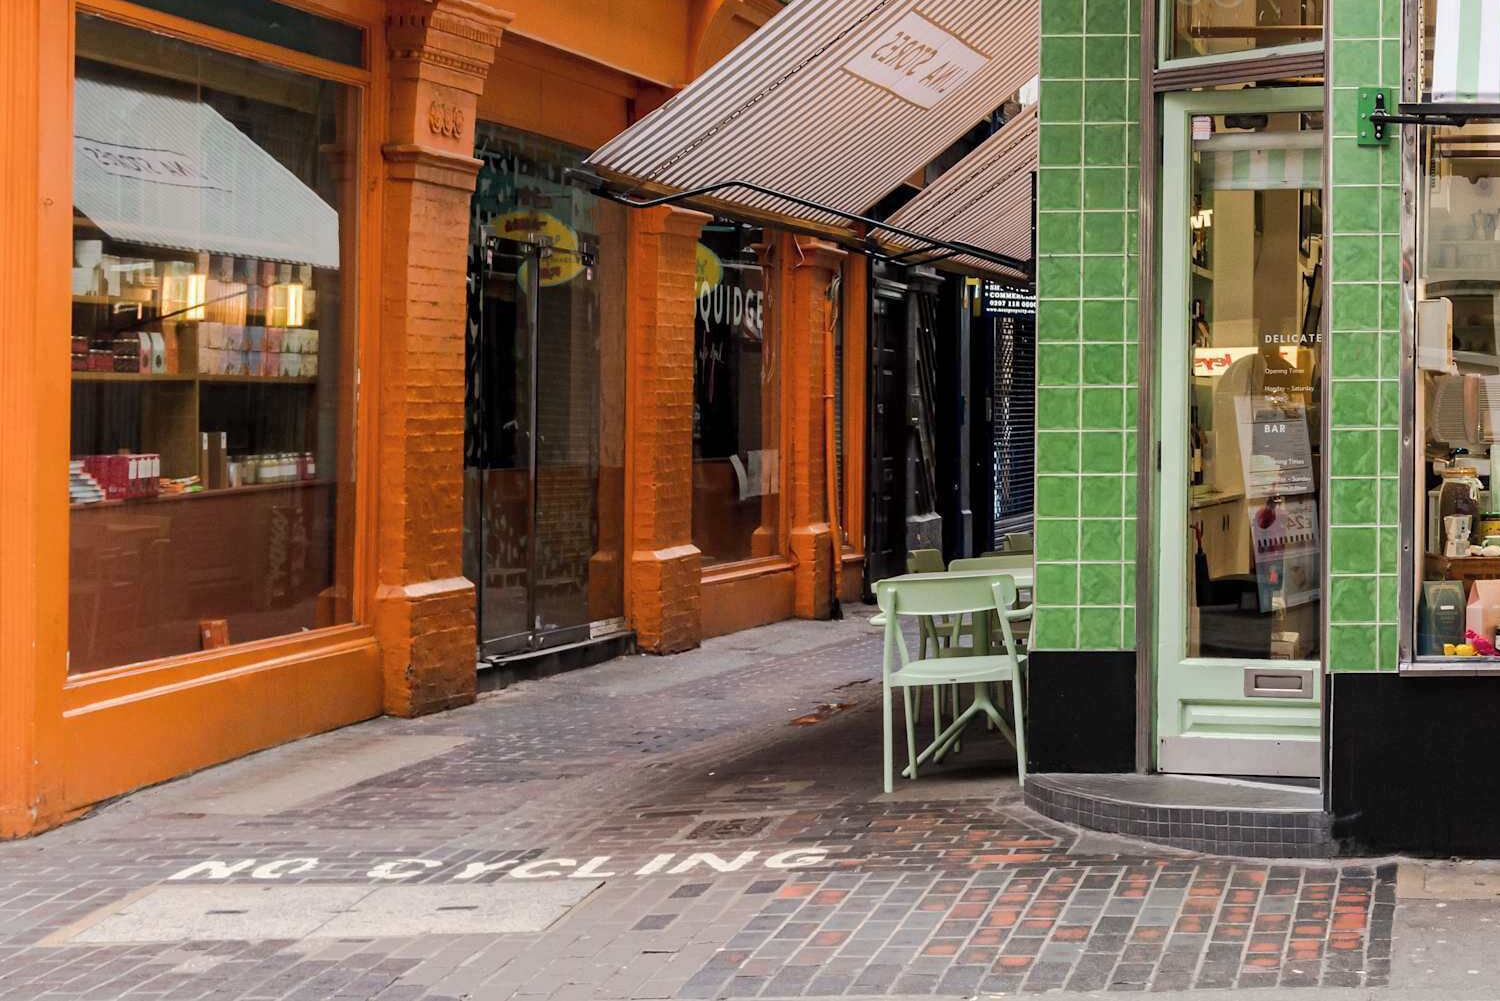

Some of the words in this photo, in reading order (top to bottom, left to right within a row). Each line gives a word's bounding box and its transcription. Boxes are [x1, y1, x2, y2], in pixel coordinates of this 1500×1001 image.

[694, 280, 764, 333] QUIDGE
[1264, 424, 1286, 433] BAR
[166, 857, 319, 881] NO
[366, 847, 834, 880] CYCLING
